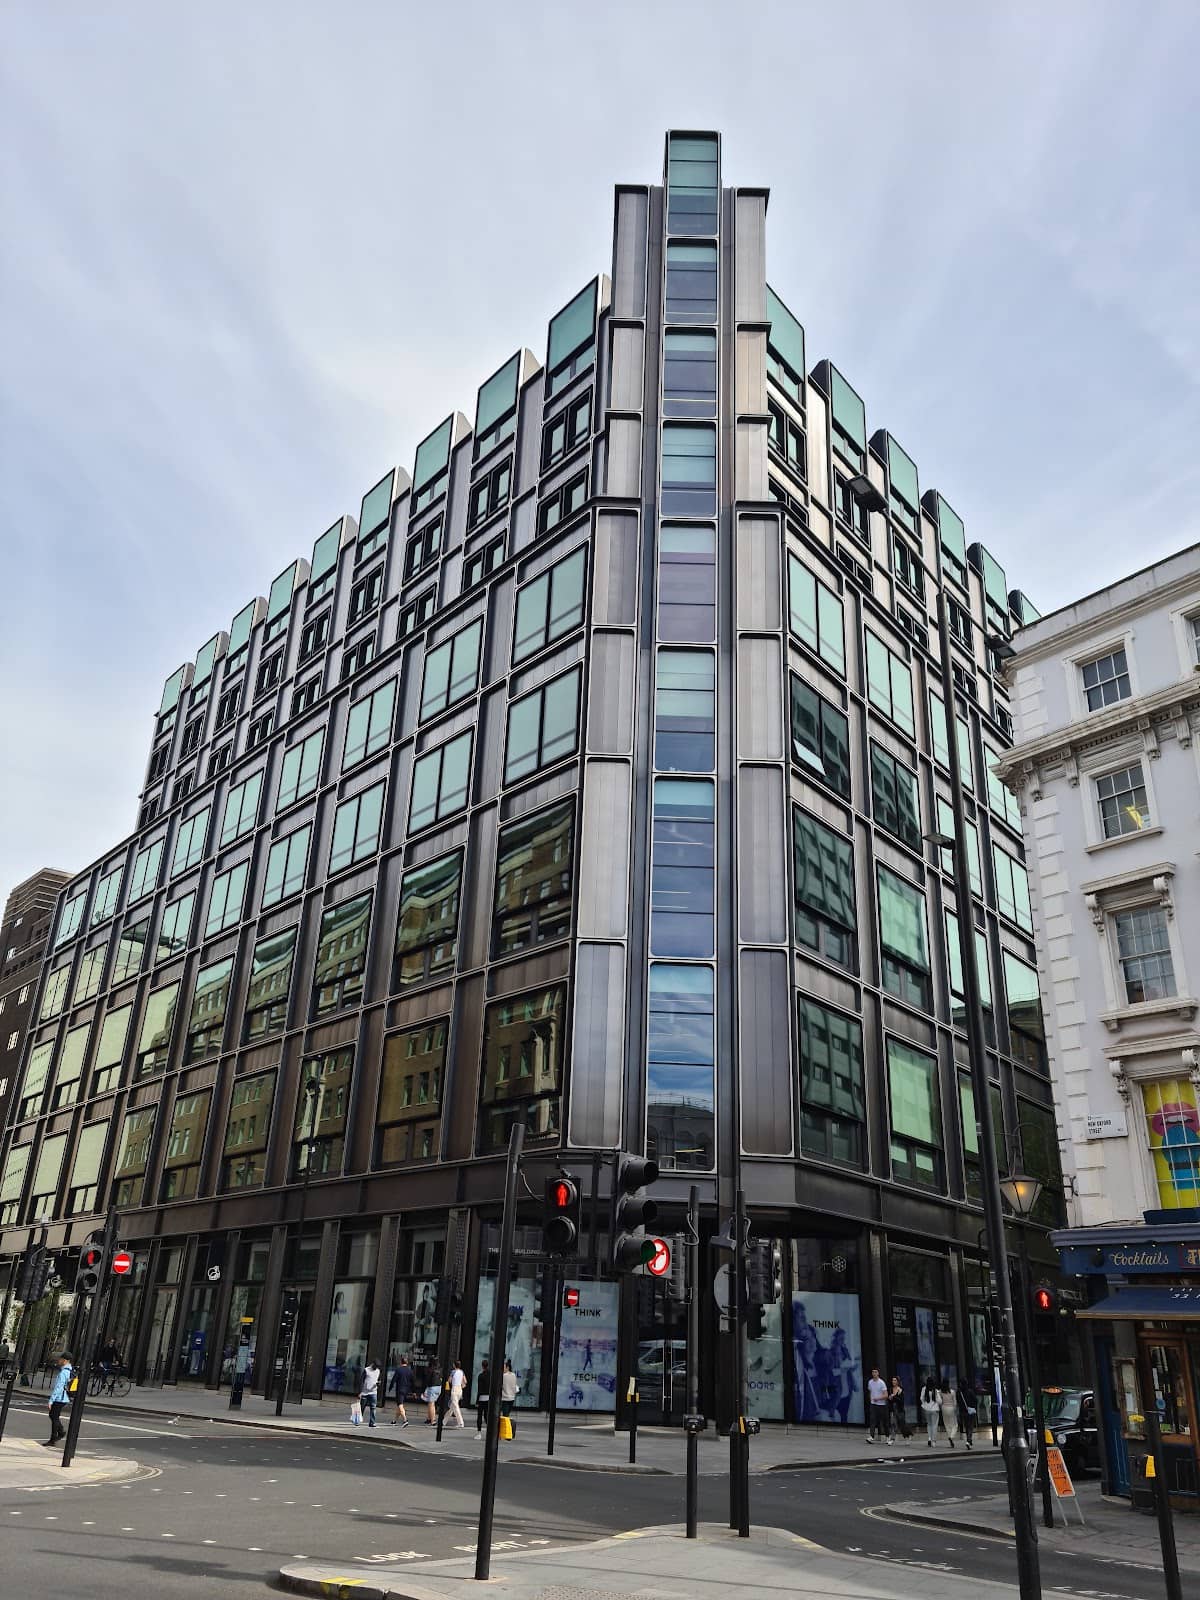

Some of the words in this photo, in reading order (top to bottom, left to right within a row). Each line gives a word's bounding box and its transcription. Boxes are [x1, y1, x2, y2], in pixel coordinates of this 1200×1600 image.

[1109, 1251, 1169, 1266] Cocktails
[575, 1308, 601, 1317] THINK
[812, 1320, 841, 1329] THINK
[574, 1373, 597, 1381] TECH
[748, 1381, 775, 1391] OORS
[352, 1550, 433, 1563] LOOK
